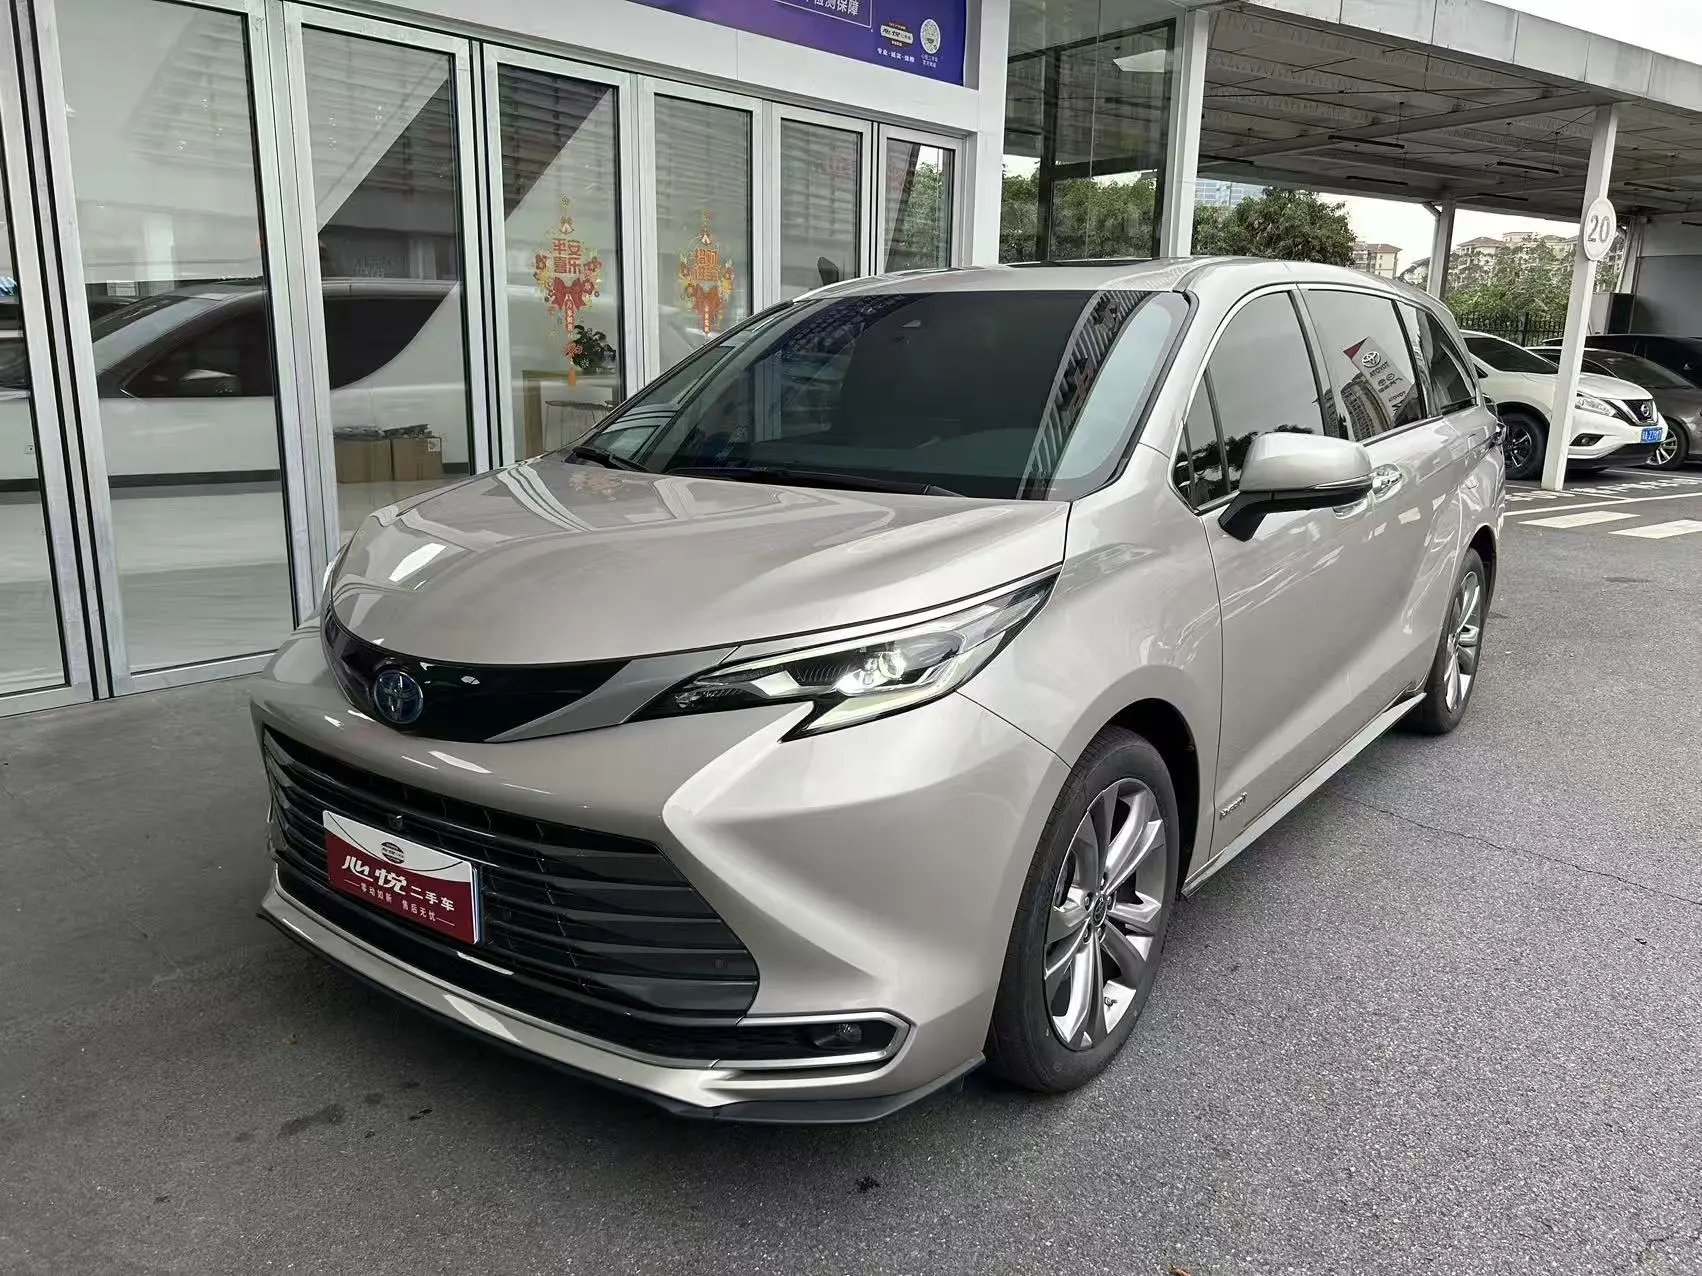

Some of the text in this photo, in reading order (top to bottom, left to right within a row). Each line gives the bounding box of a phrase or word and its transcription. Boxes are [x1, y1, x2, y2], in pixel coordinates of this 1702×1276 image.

[1587, 215, 1610, 243] 20
[552, 238, 581, 256] 平安
[553, 256, 582, 274] 喜乐
